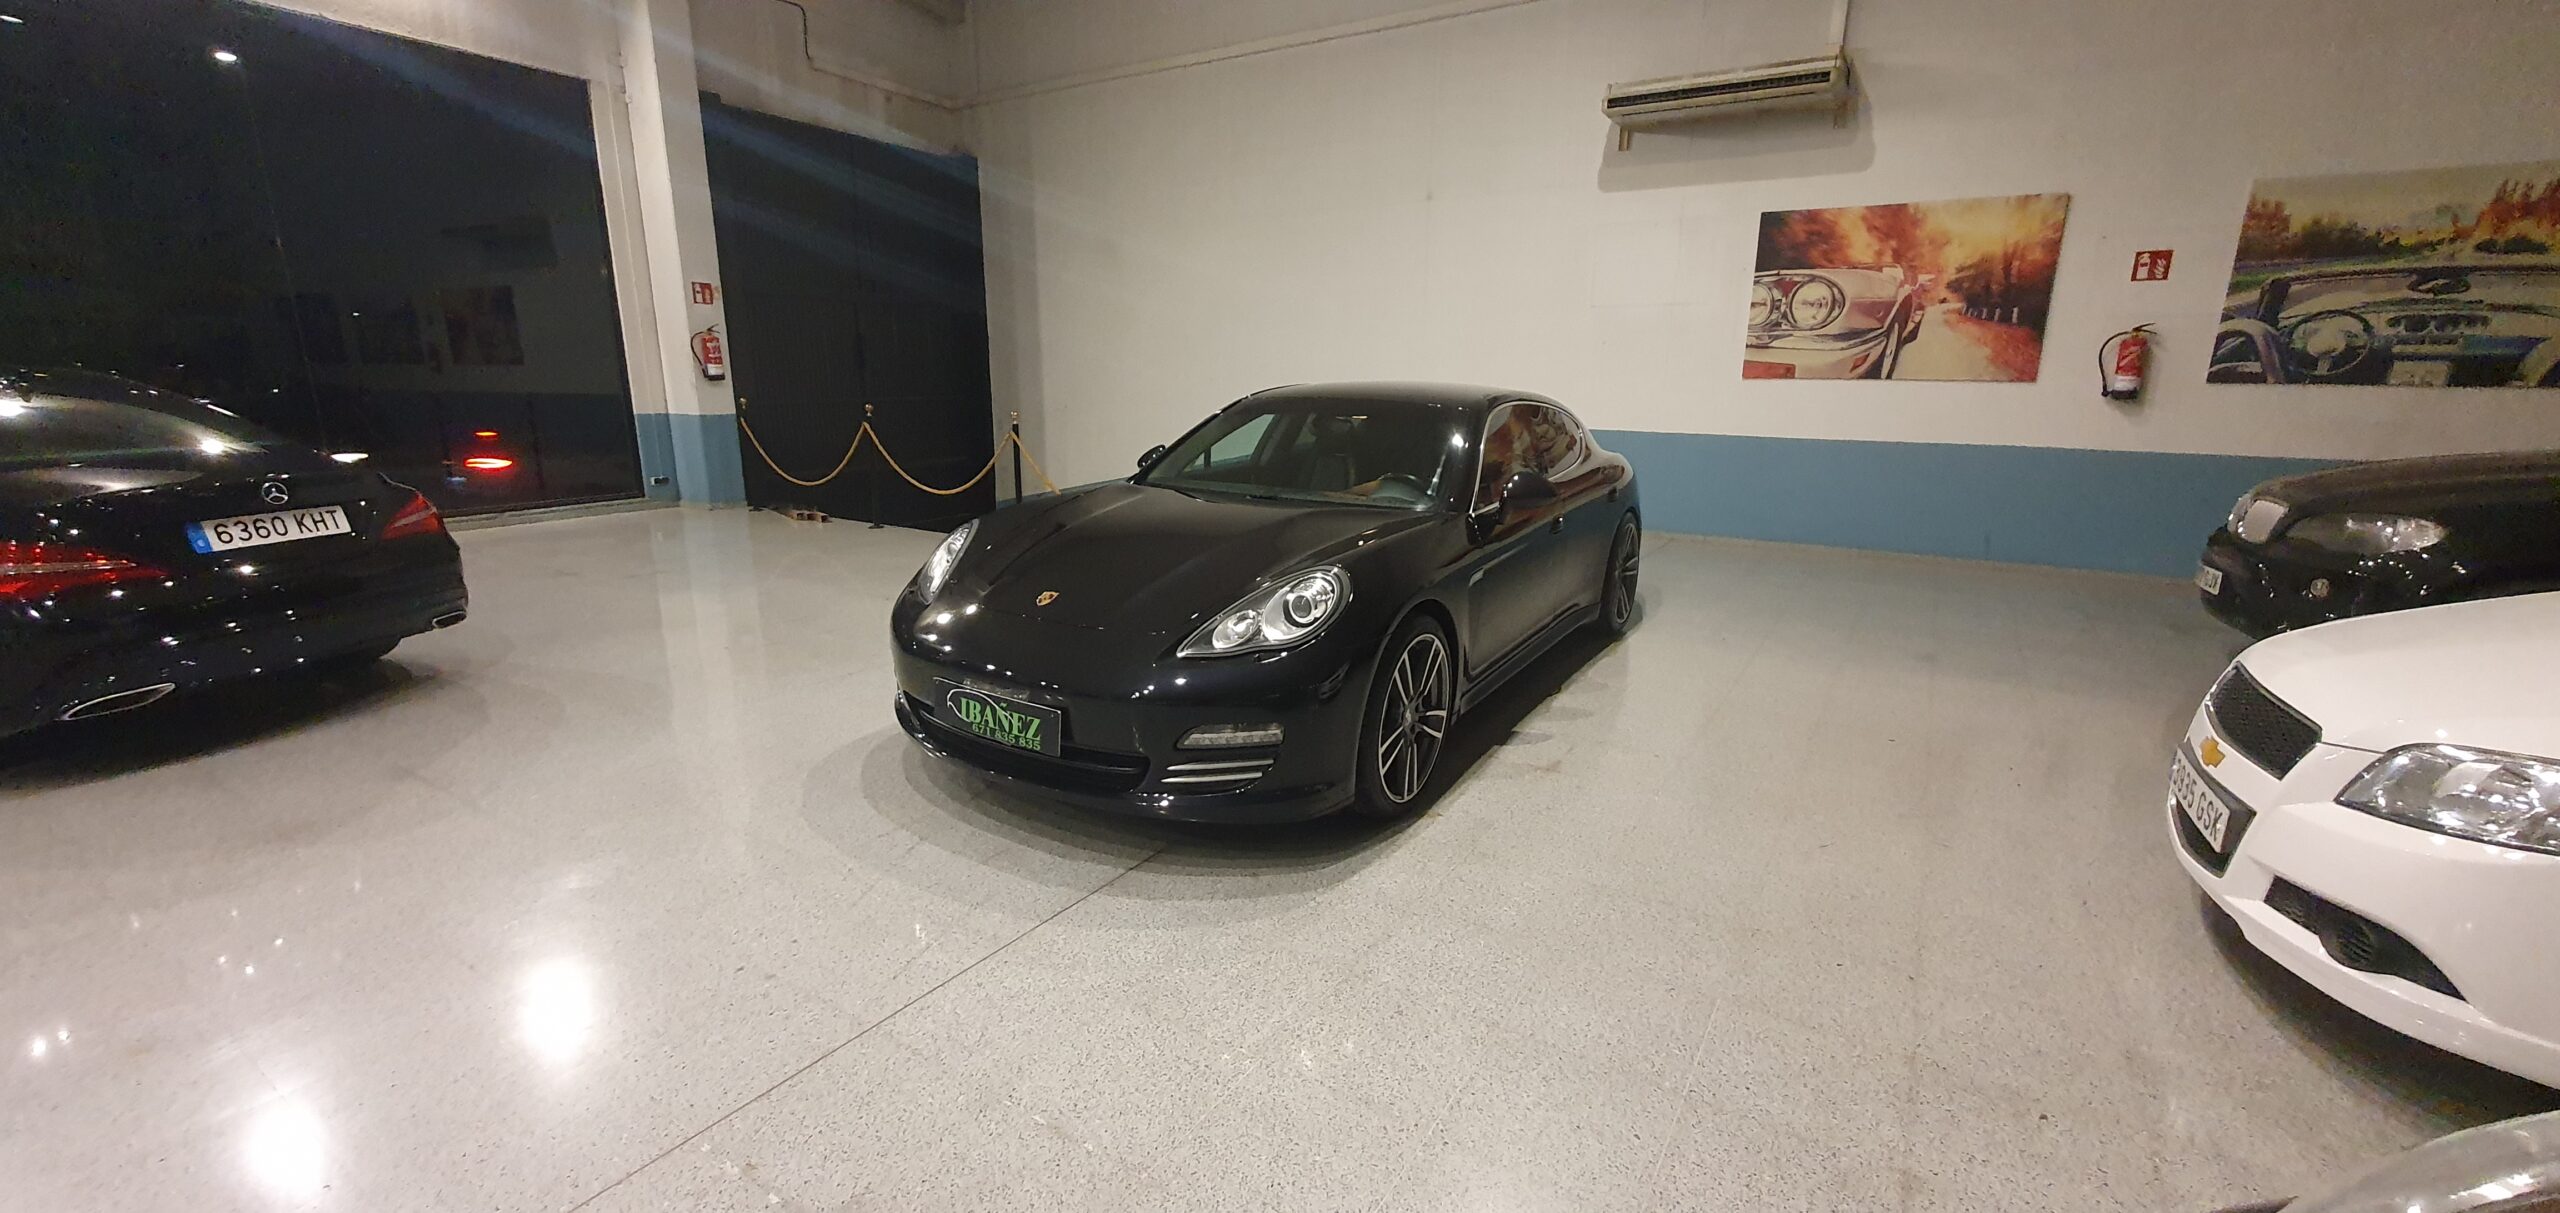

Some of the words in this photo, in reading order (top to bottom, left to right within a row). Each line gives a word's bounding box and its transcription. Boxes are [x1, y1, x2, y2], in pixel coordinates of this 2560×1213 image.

[214, 516, 288, 544] 6360
[293, 510, 340, 534] KHT
[960, 697, 1041, 741] IBAÑEZ
[972, 723, 992, 737] 671
[994, 731, 1016, 744] 835
[1019, 738, 1041, 751] 835
[2196, 791, 2223, 842] GSK
